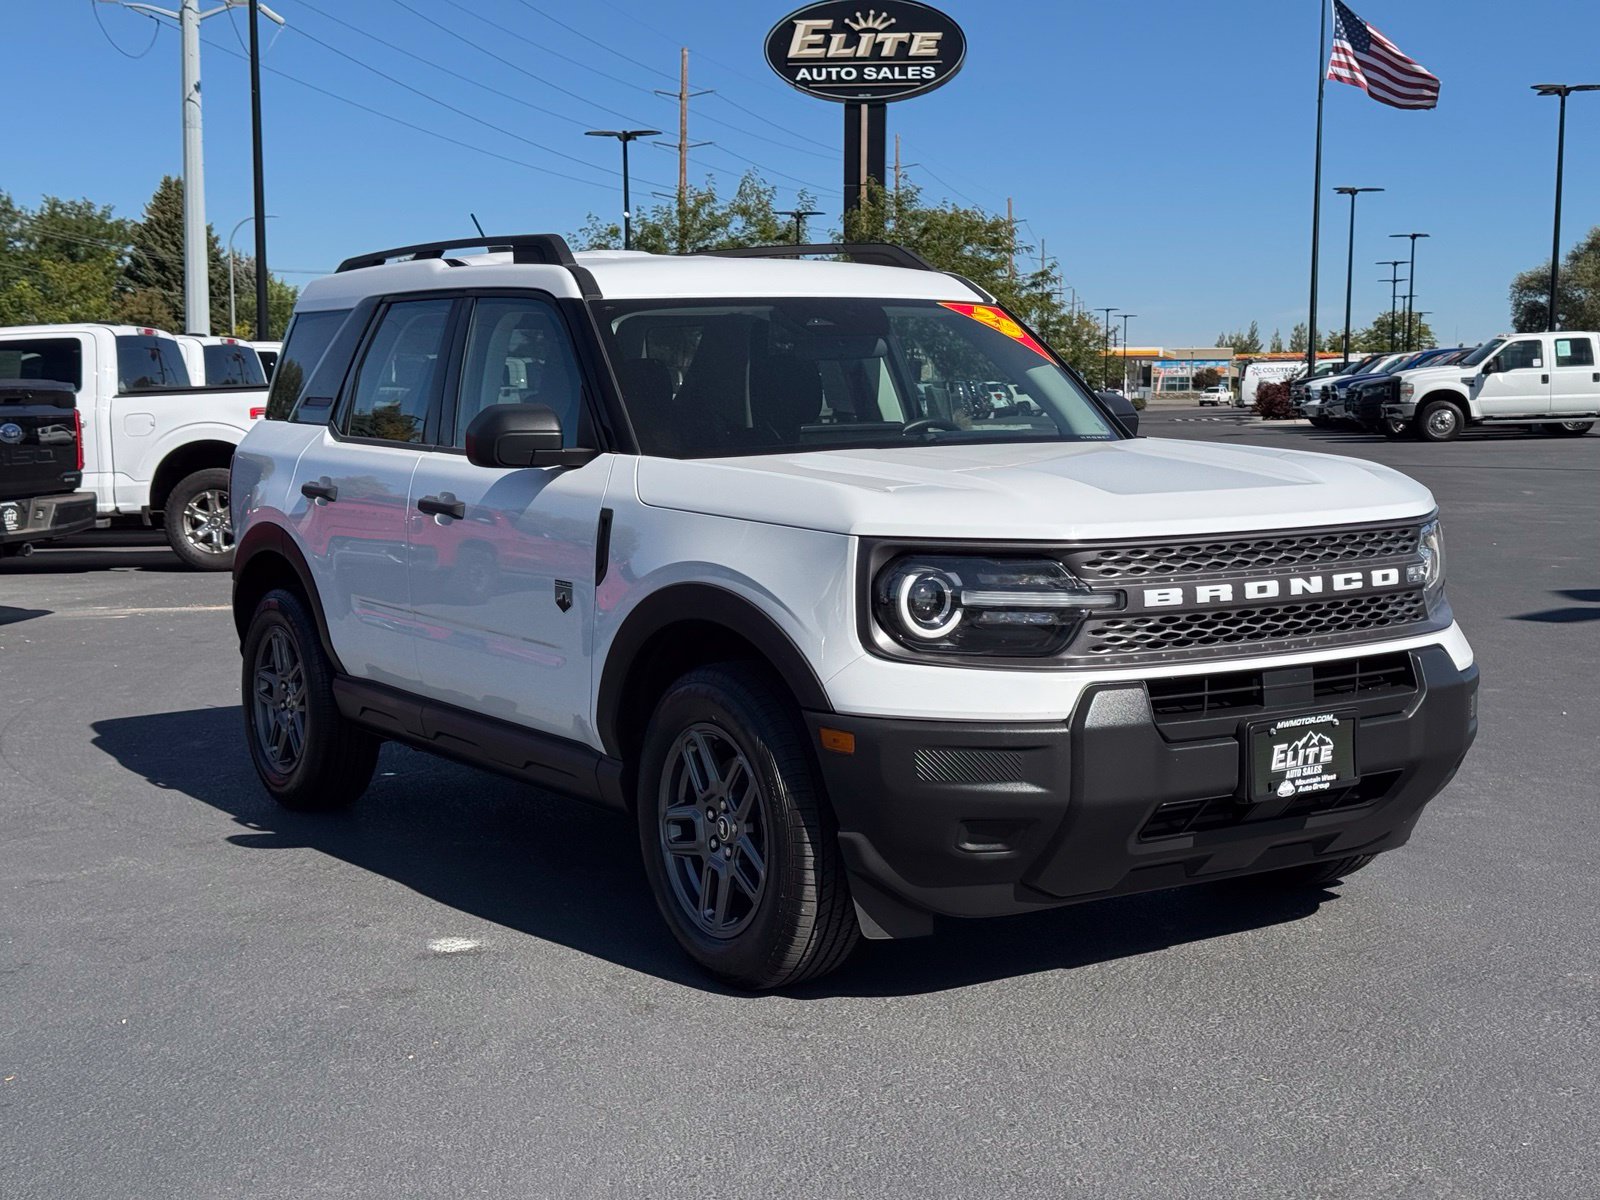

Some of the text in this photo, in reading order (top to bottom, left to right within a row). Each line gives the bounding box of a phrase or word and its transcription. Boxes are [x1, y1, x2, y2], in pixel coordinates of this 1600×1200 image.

[787, 19, 943, 58] ELITE
[796, 66, 936, 81] AUTO SALES
[1144, 568, 1399, 607] BRONCO
[1277, 714, 1334, 729] MWMOTOR.COM
[1271, 743, 1334, 771] ELITE
[1286, 765, 1323, 779] AUTO SALES
[1295, 776, 1321, 786] Mountain
[1298, 782, 1330, 793] Auto Group
